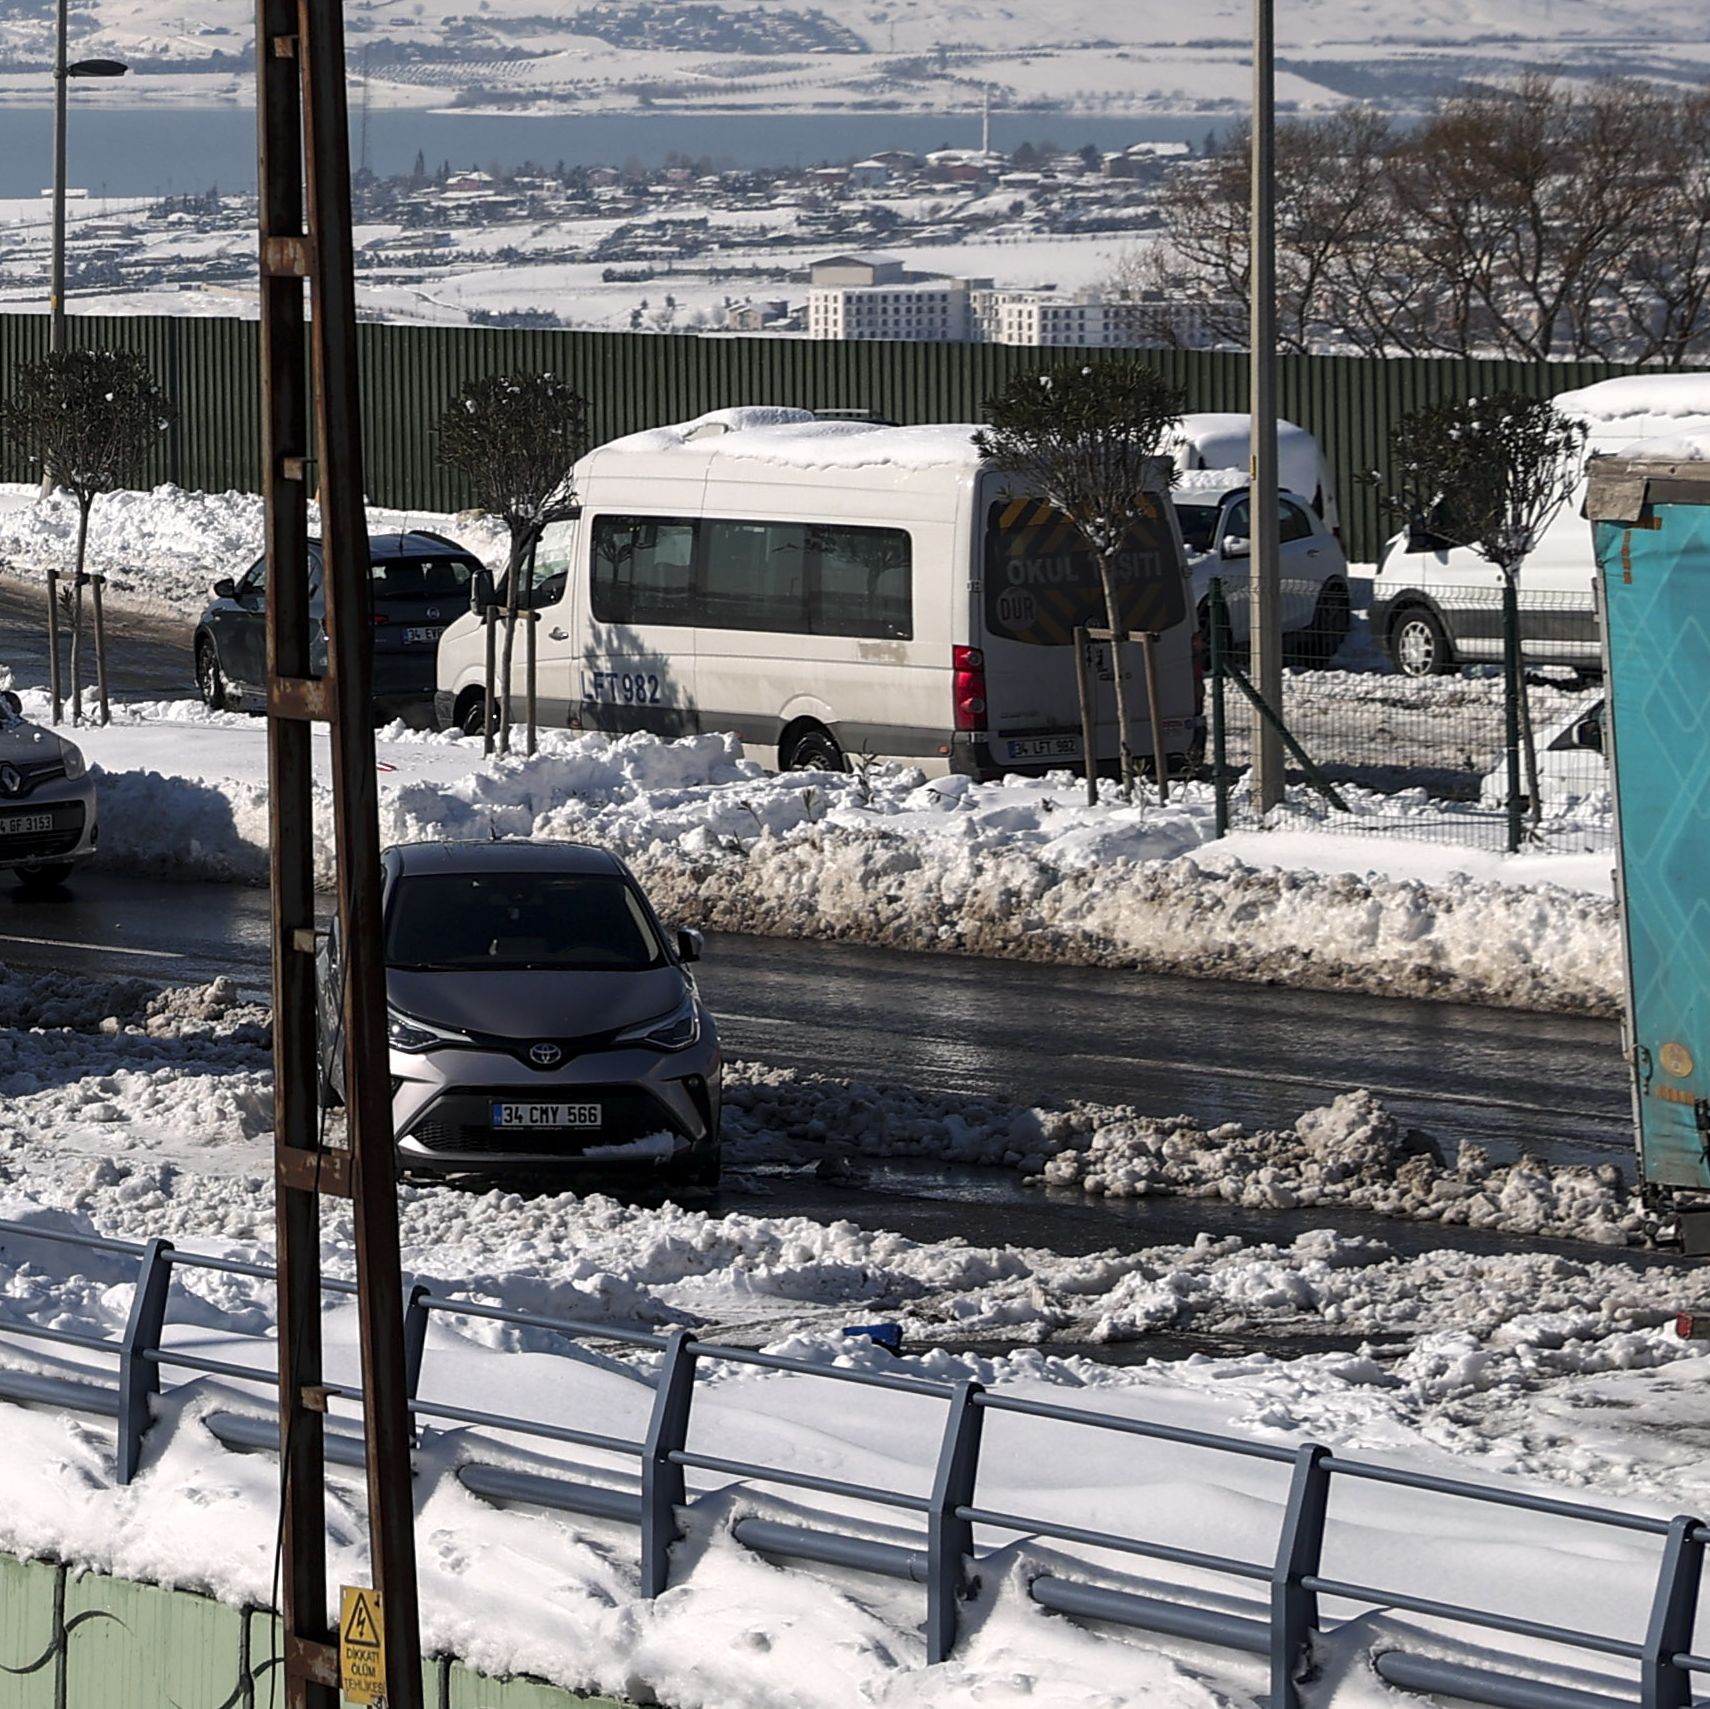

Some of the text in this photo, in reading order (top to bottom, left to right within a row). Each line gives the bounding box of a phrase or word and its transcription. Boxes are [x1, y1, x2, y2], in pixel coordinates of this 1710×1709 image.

[1007, 556, 1080, 586] OKUL
[1000, 596, 1035, 621] DUR
[581, 671, 661, 703] LFT 982
[26, 816, 51, 831] 3153
[503, 1105, 523, 1124] 34
[529, 1105, 560, 1124] CMY
[567, 1105, 598, 1124] 566
